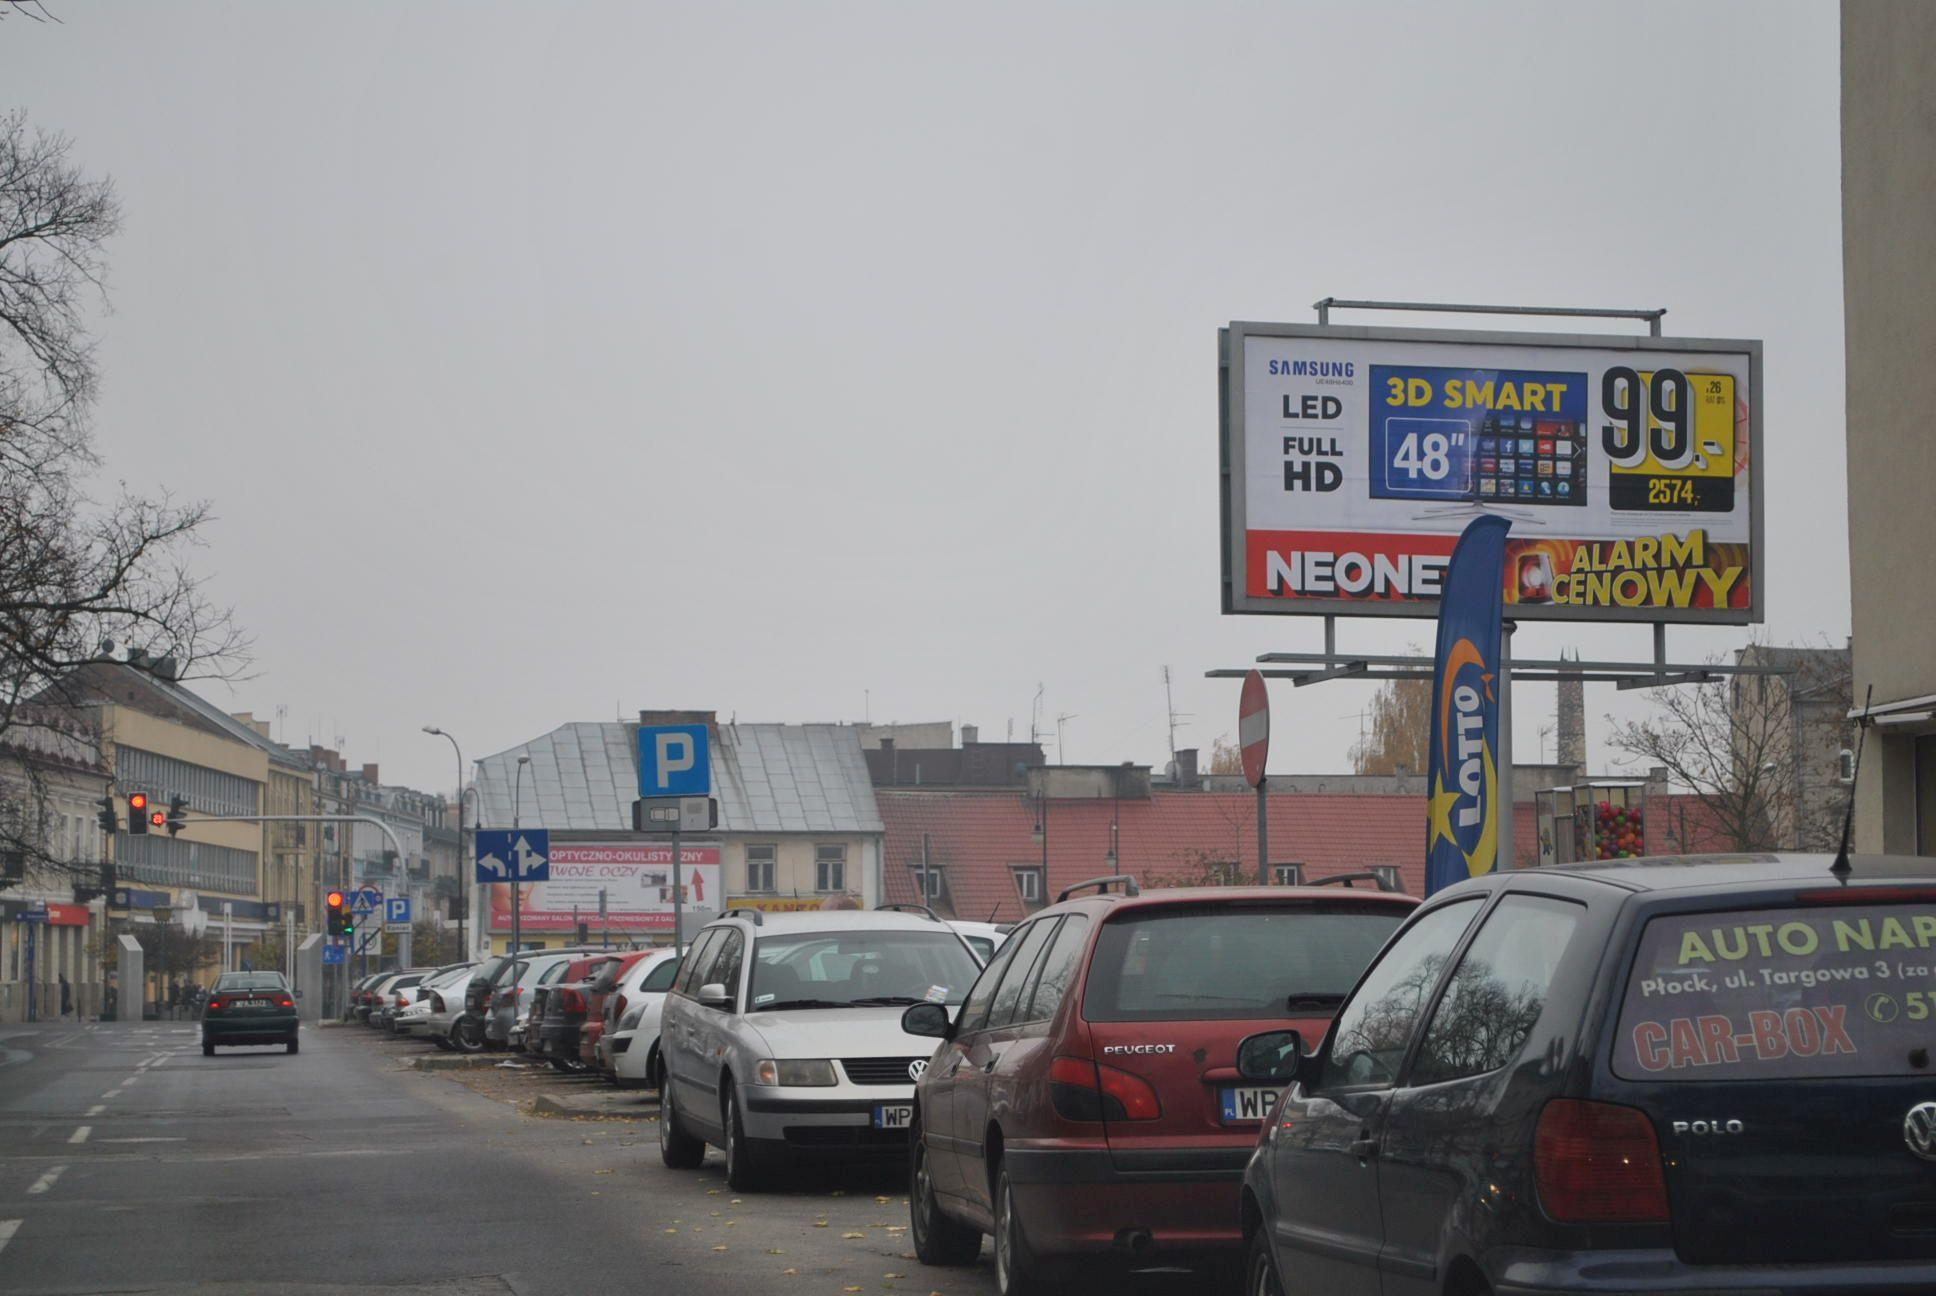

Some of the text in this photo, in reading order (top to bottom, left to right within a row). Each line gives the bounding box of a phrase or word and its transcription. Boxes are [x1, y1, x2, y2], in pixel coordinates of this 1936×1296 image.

[1269, 360, 1354, 377] SAMSUNG
[1283, 395, 1342, 419] LED
[1386, 377, 1568, 412] 3D SMART
[1283, 437, 1343, 456] FULL
[1284, 461, 1343, 492] HD
[1570, 530, 1706, 574] ALARM
[1552, 566, 1745, 609] CENOWY
[656, 732, 695, 788] P
[1454, 685, 1484, 827] LOTTO
[550, 850, 703, 862] OPTYCZNO-OKULISTYZNY
[392, 901, 405, 919] P
[1678, 922, 1820, 965] AUTO
[1641, 961, 1929, 997] Płock, ul. Targowa 3 (za
[1104, 1043, 1175, 1055] PEUGEOT
[1632, 1005, 1857, 1071] CAR-BOX
[1673, 1119, 1744, 1135] POLO
